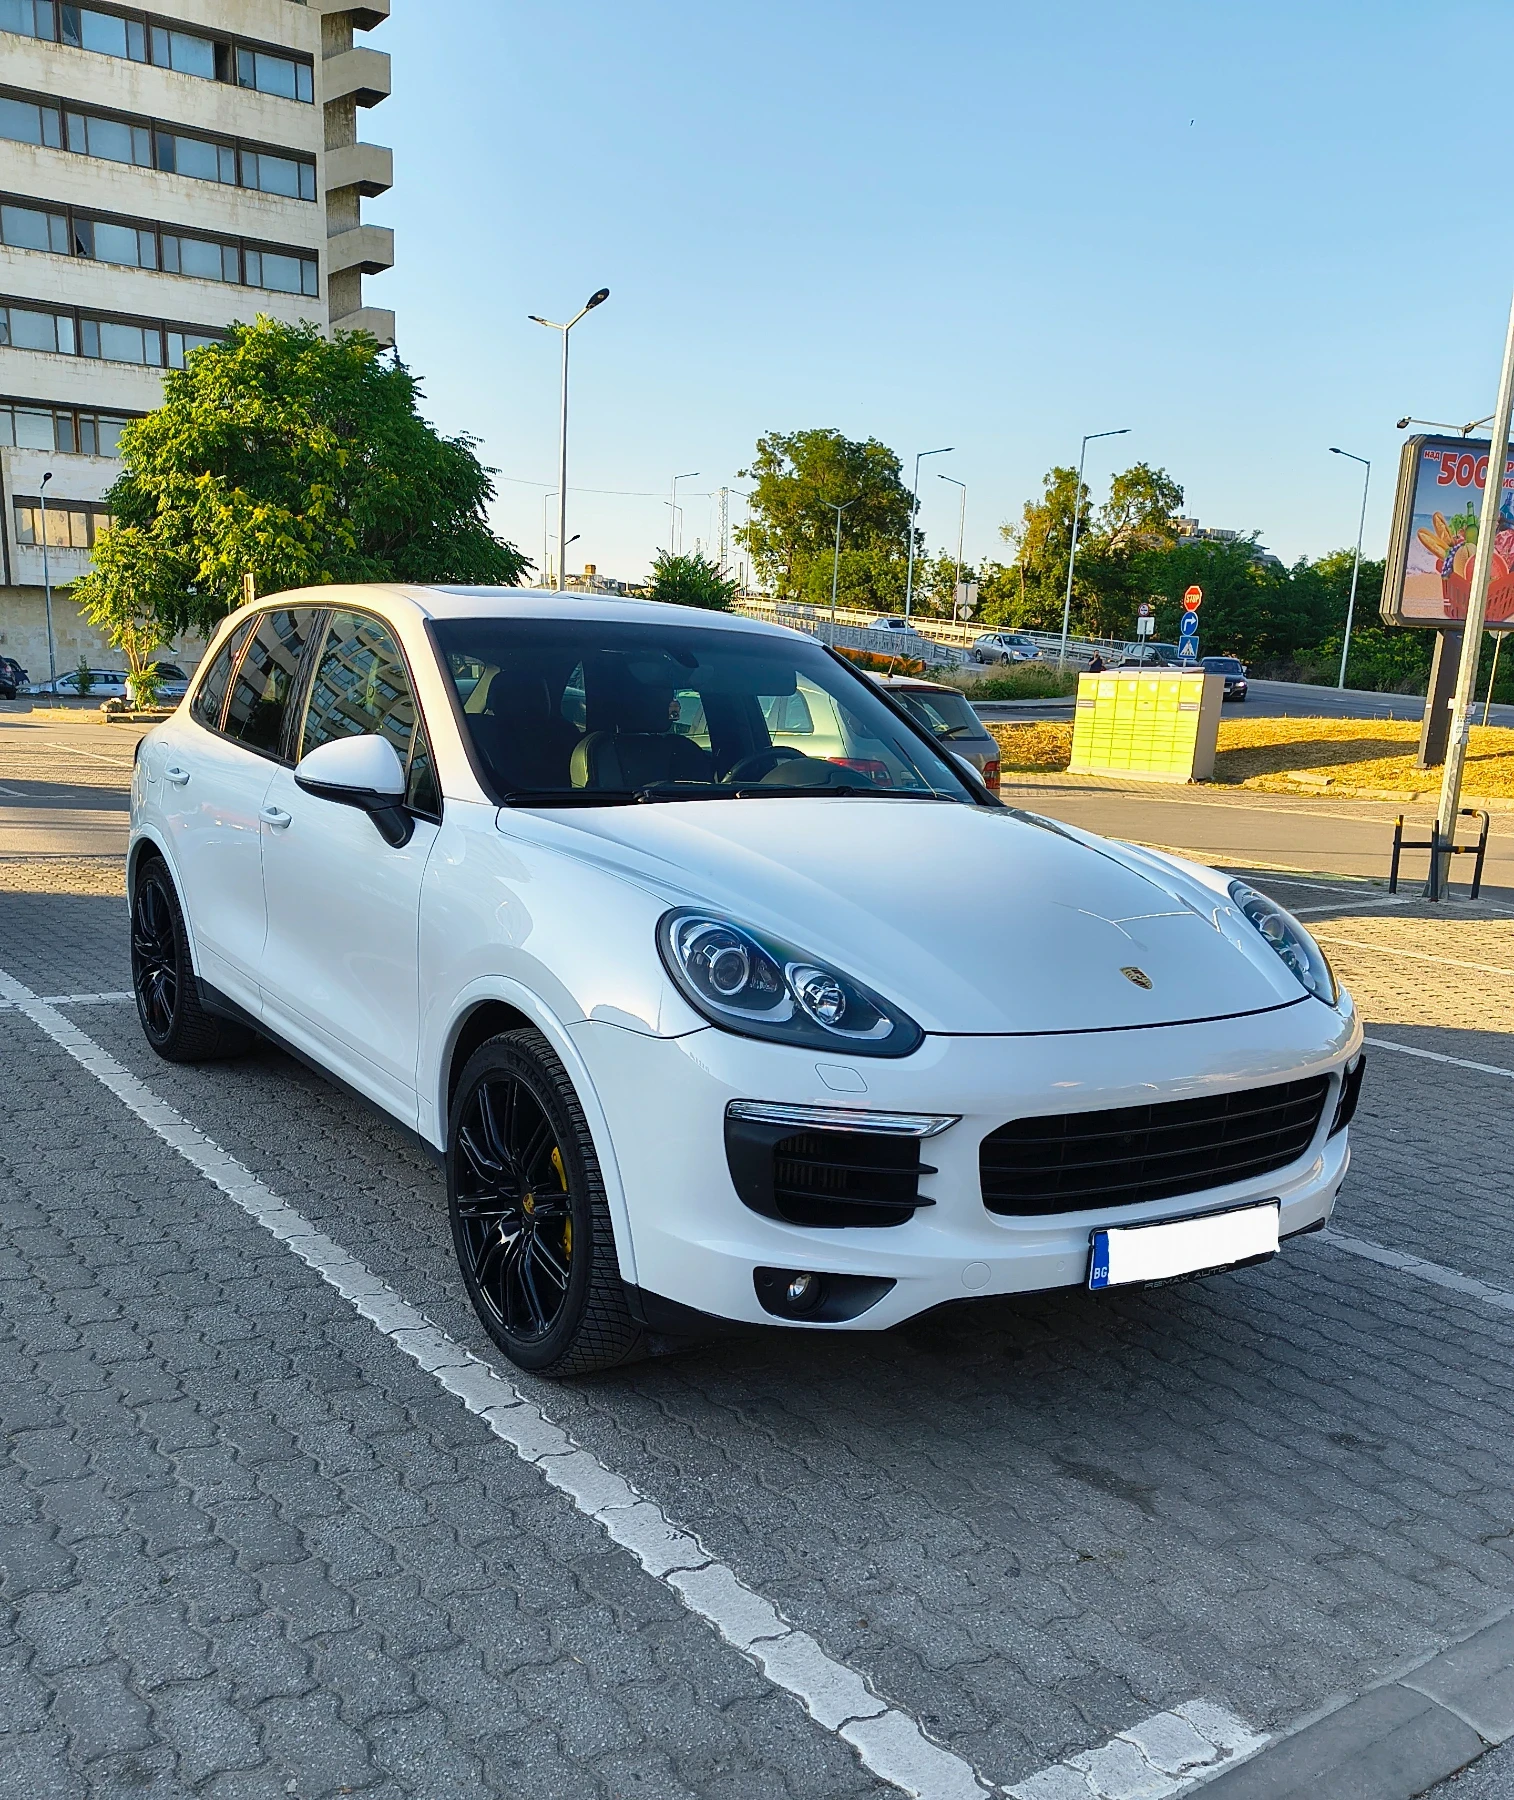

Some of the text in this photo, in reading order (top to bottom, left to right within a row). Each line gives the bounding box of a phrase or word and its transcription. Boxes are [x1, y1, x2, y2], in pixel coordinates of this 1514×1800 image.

[1186, 594, 1200, 603] STOP
[1094, 1267, 1107, 1279] BG
[1194, 1265, 1228, 1279] AUTO
